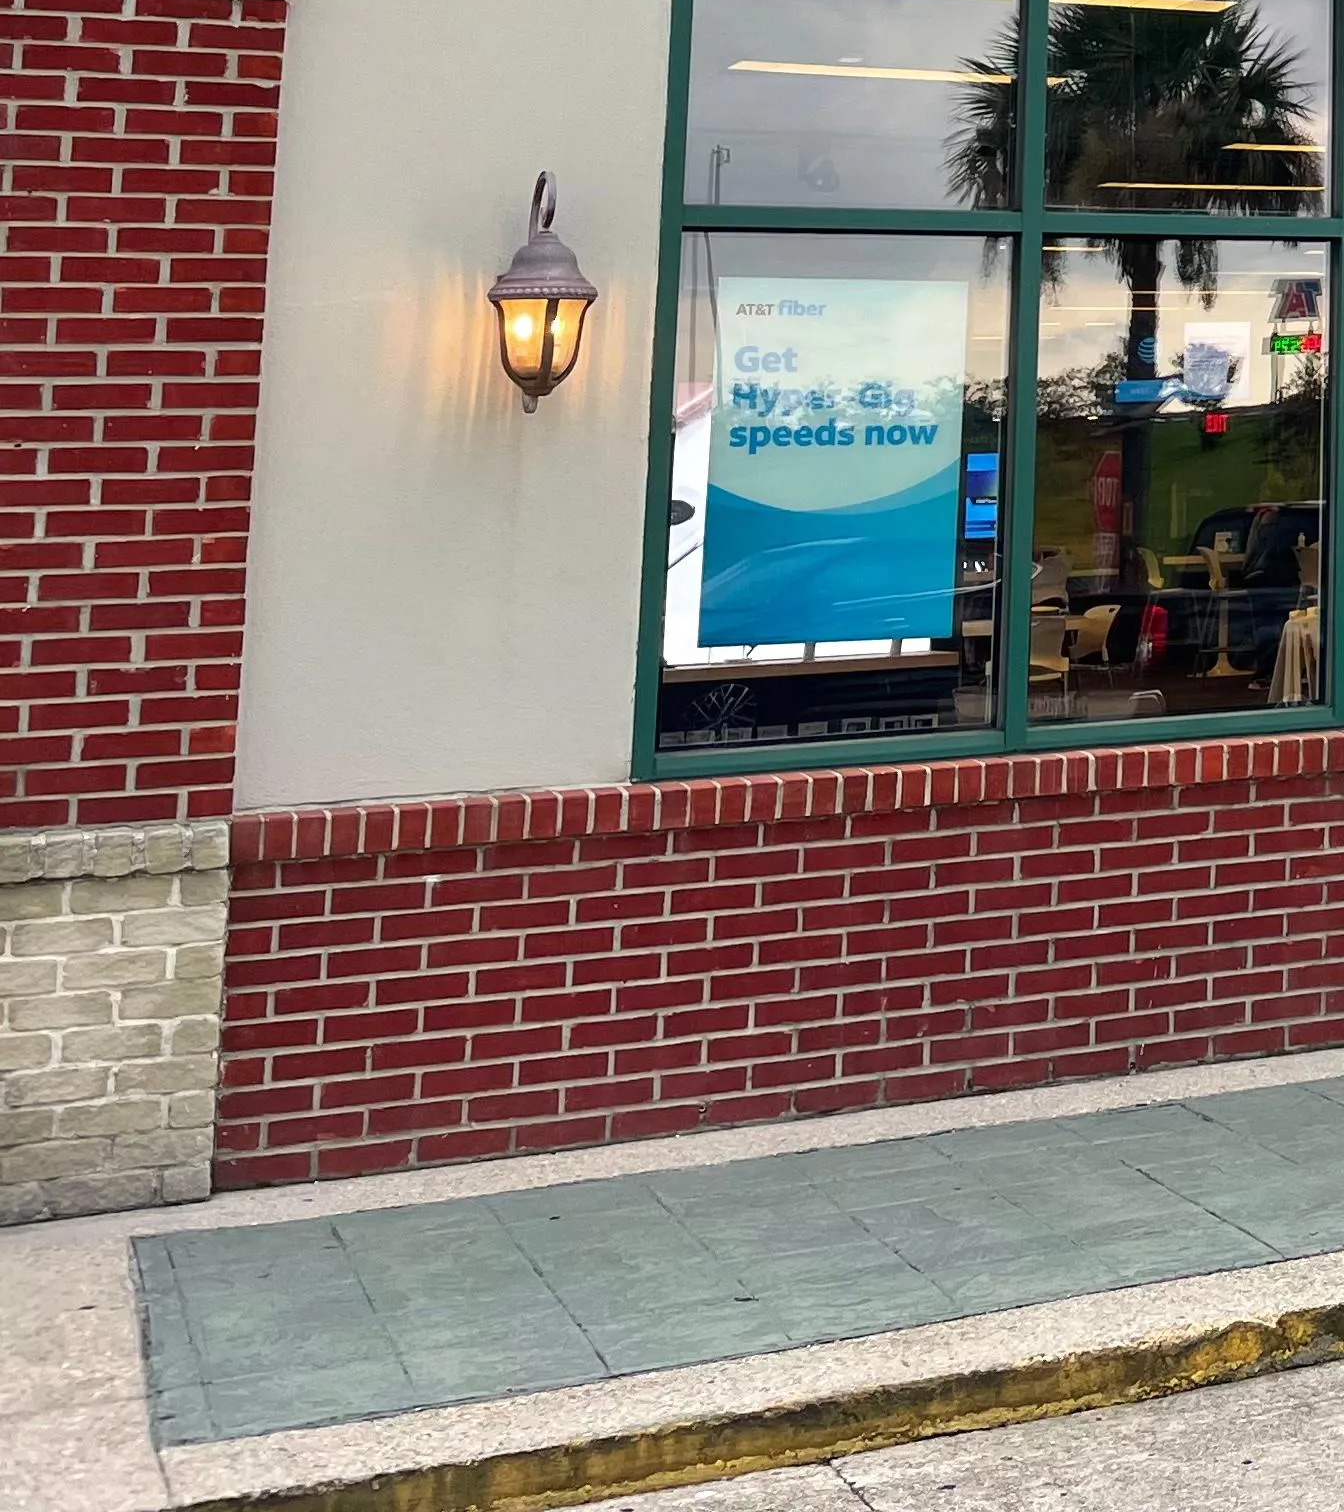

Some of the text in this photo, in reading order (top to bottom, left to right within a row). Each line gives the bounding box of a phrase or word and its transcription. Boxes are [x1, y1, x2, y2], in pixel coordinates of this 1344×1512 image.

[736, 300, 827, 316] AT&T fiber
[734, 346, 797, 372] Get
[729, 418, 939, 455] speeds now
